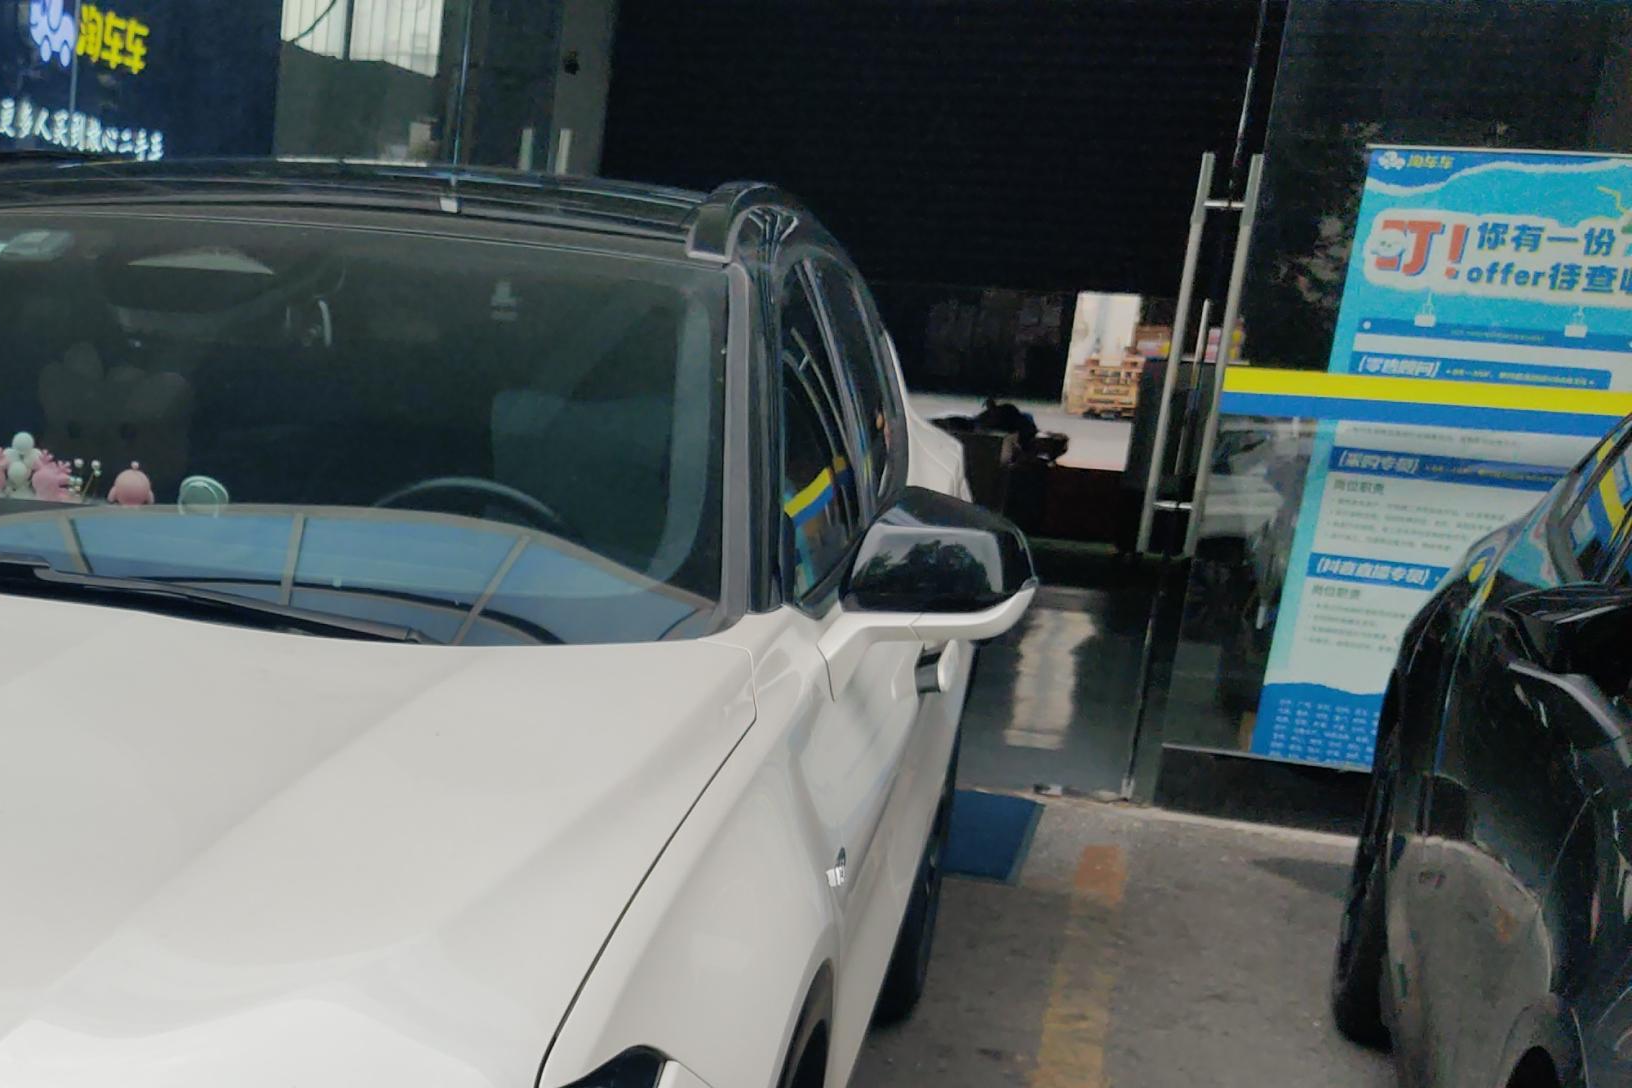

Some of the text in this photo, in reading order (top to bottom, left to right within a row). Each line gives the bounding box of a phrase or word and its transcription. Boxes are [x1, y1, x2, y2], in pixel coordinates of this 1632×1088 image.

[76, 3, 150, 75] 淘车车
[1477, 221, 1616, 257] 你有一份
